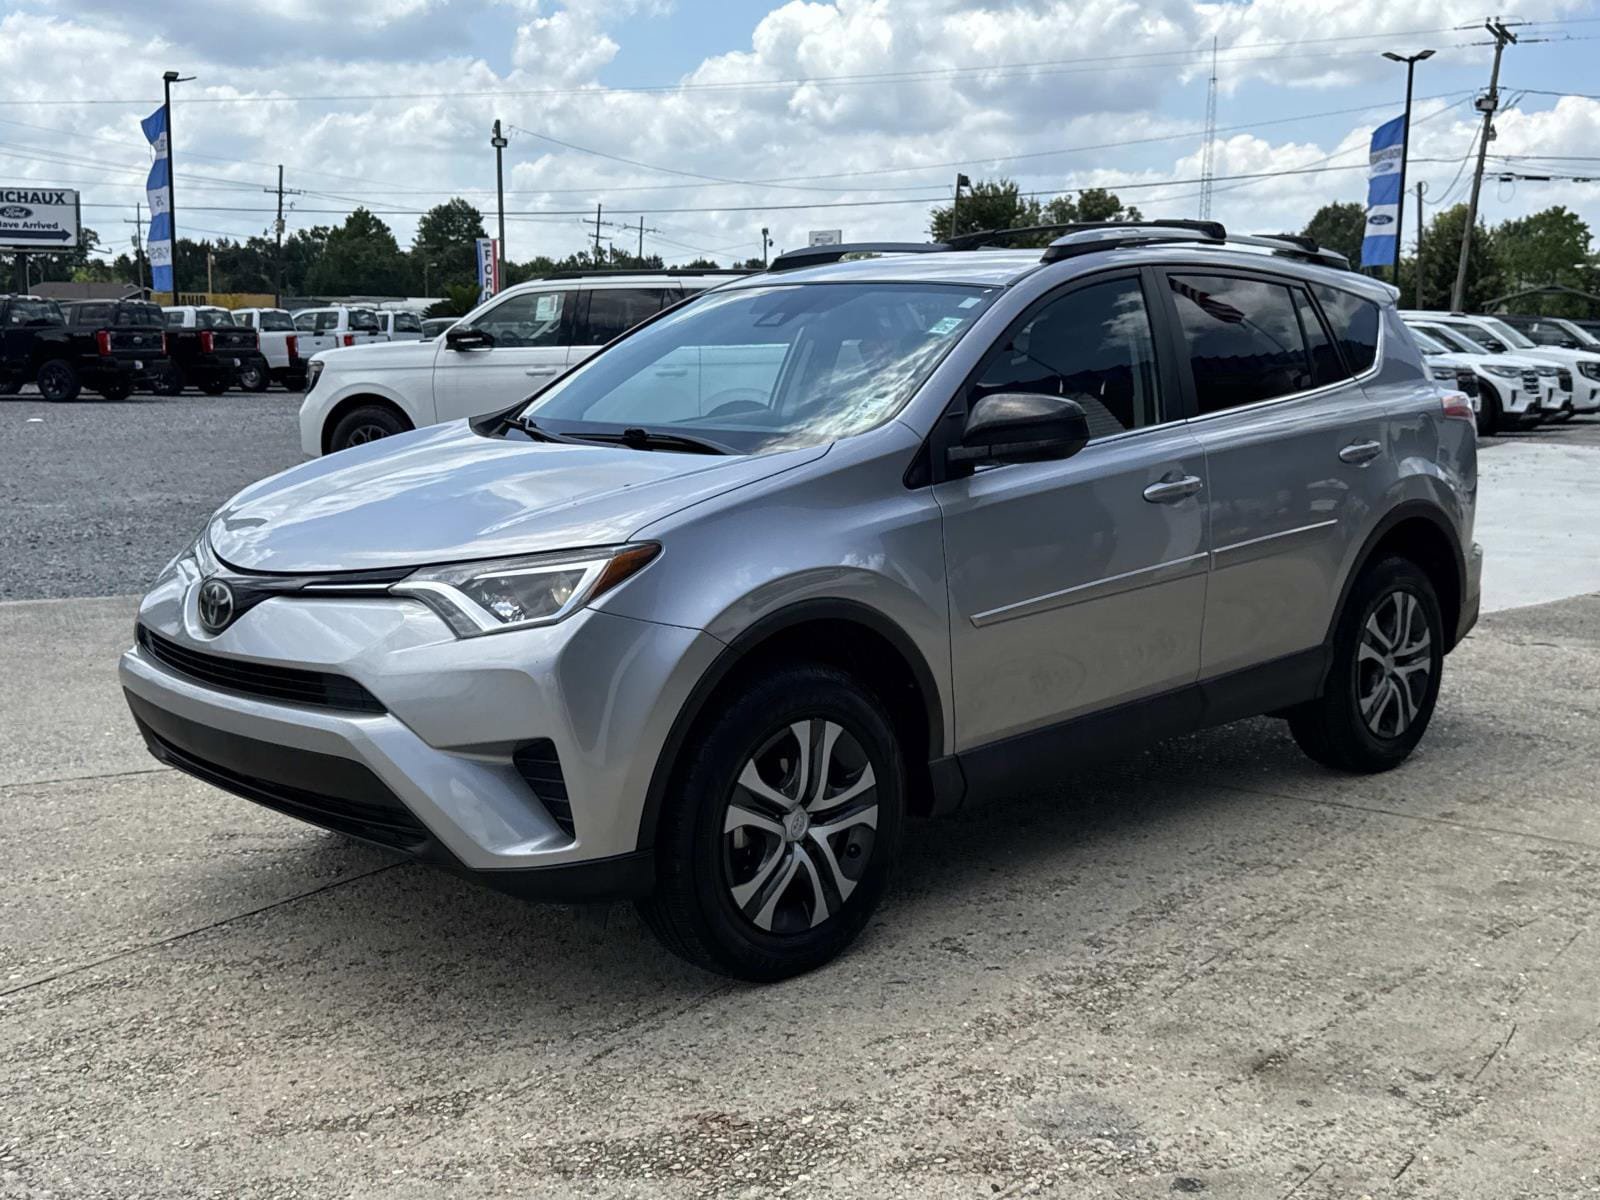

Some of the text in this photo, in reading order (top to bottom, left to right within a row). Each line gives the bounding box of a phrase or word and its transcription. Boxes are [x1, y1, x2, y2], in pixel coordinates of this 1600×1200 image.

[0, 220, 59, 230] ave Arrived
[484, 249, 493, 301] FORD
